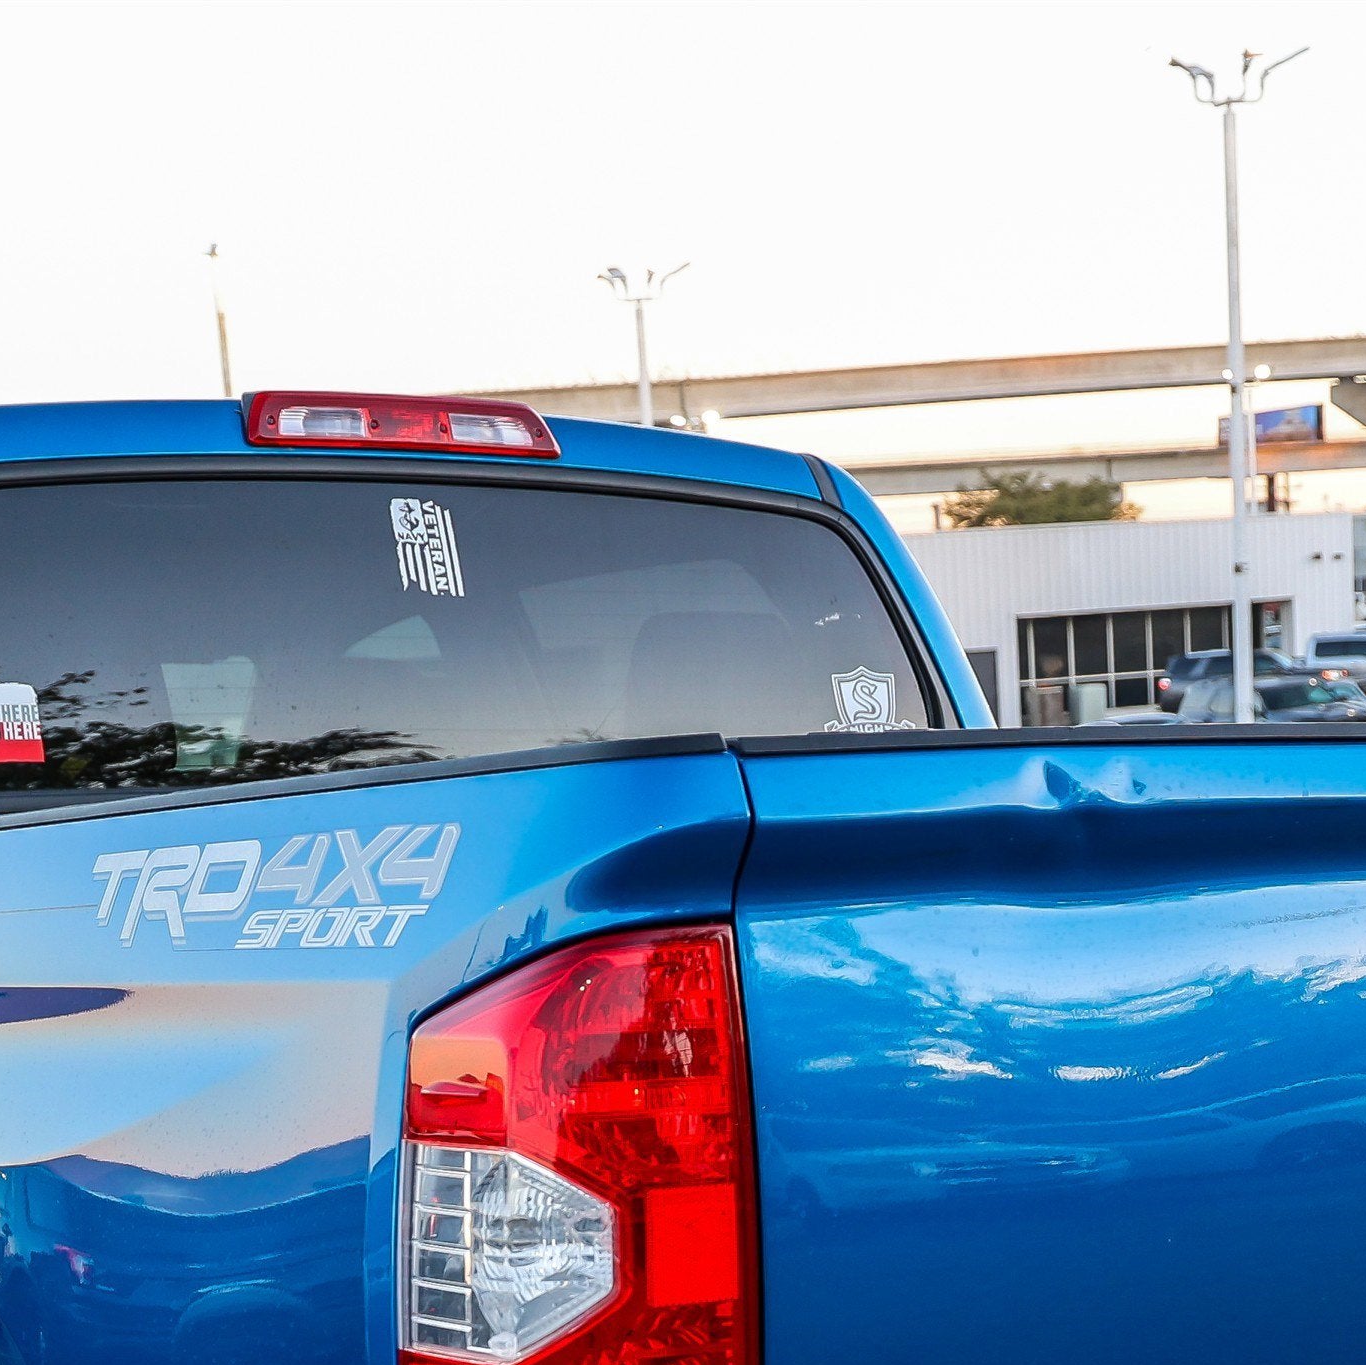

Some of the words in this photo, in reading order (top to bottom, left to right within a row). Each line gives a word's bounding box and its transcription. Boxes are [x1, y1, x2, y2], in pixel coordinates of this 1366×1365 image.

[397, 531, 426, 541] NAVY
[422, 500, 449, 591] VETERAN
[1, 704, 40, 722] HERE
[3, 721, 42, 741] HERE
[235, 904, 430, 949] SPORT
